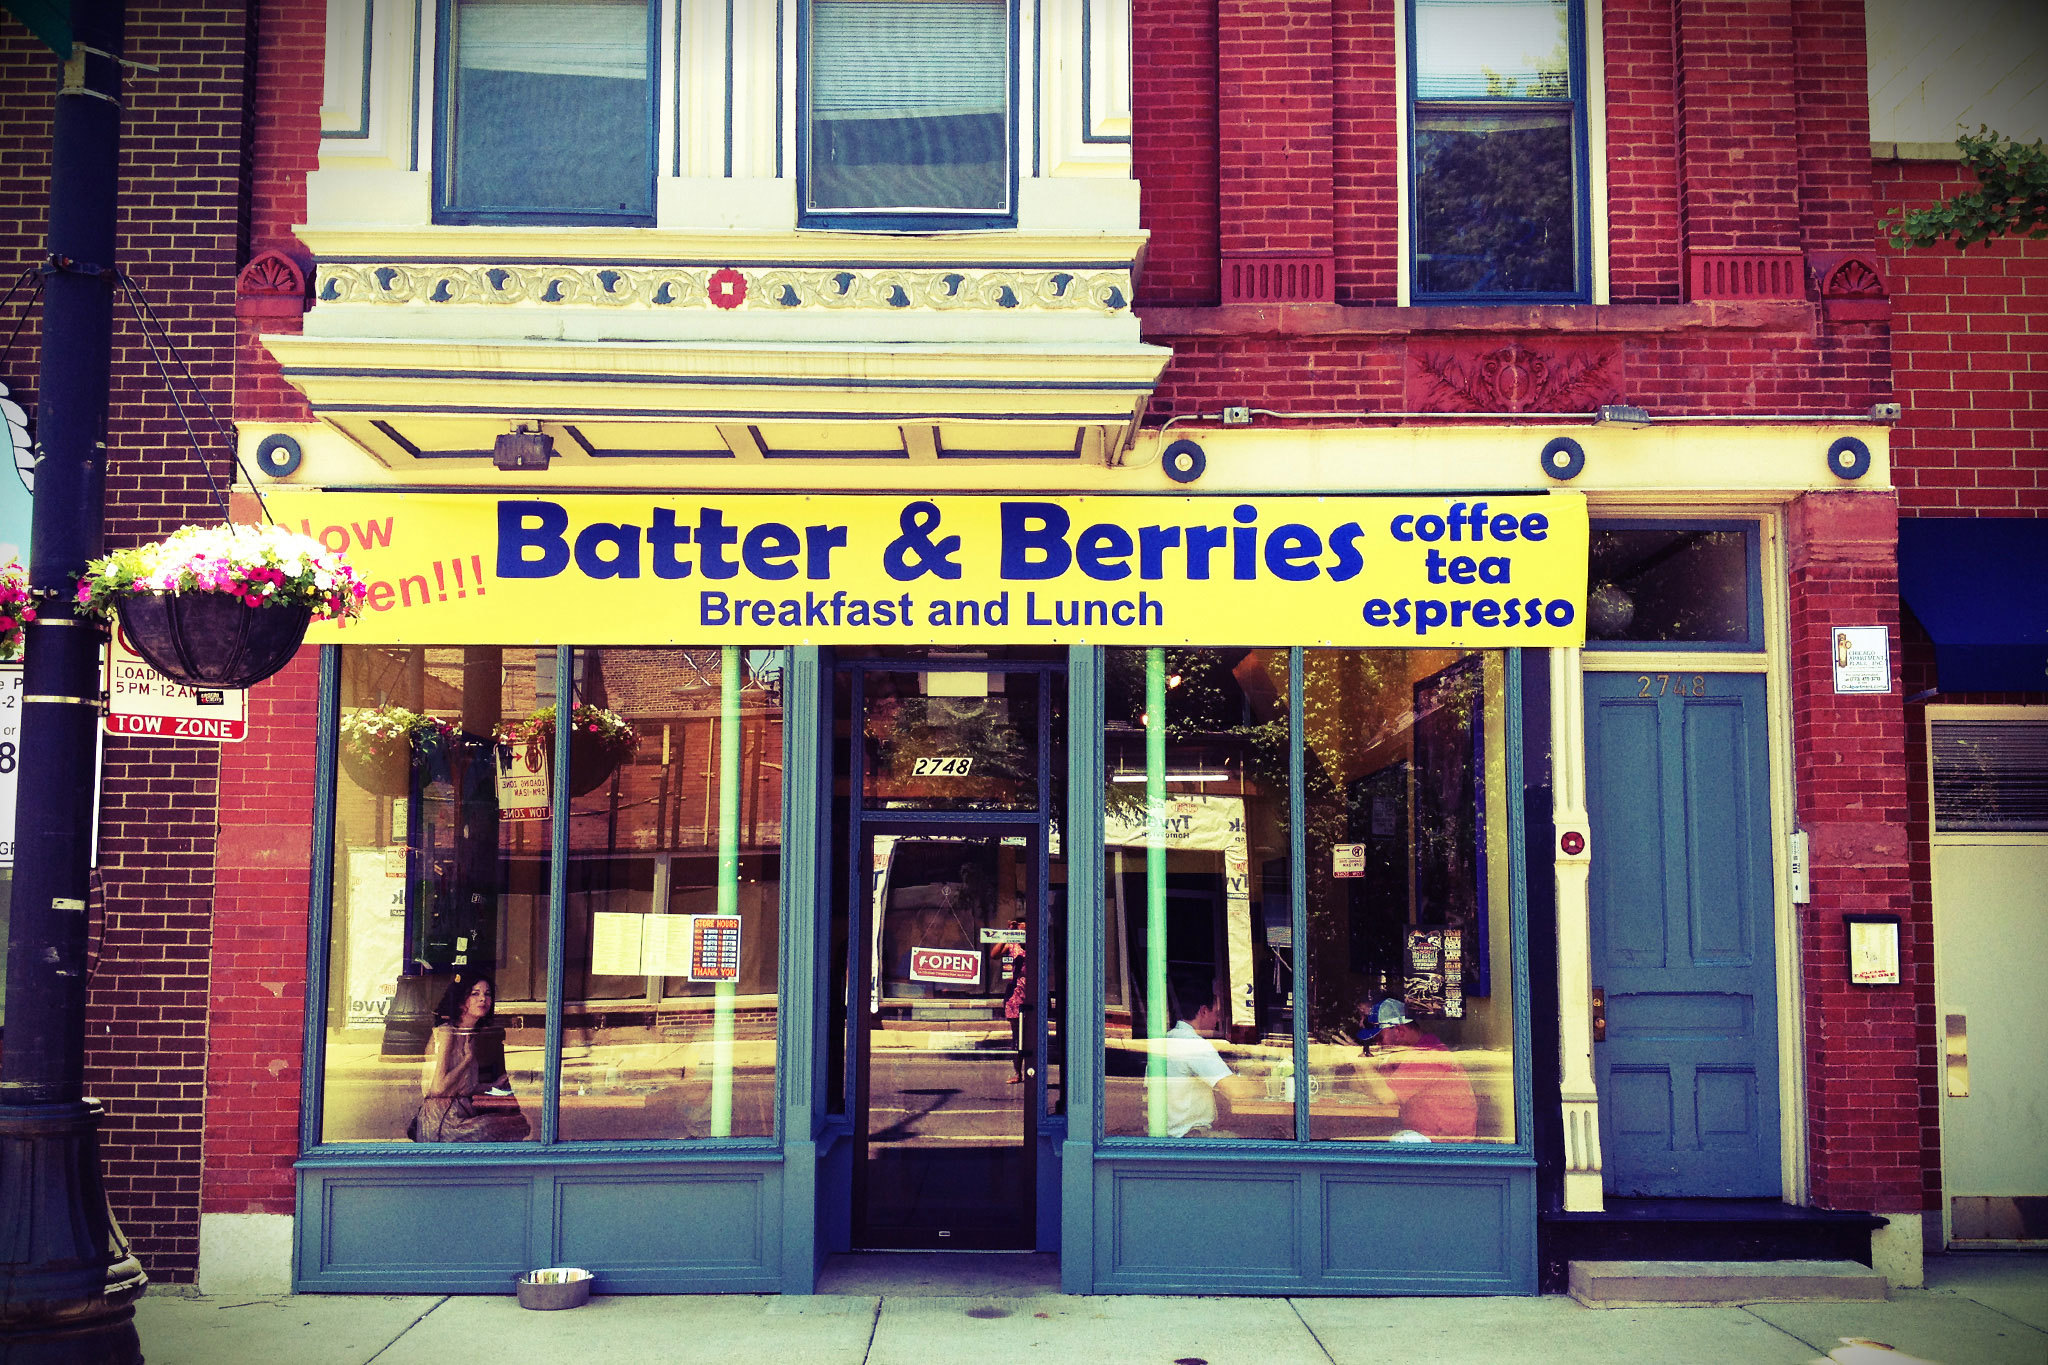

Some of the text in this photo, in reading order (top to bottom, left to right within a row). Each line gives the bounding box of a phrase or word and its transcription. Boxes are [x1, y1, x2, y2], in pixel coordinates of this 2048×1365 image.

[1390, 502, 1549, 542] coffee
[496, 500, 1365, 582] Batter & Berries
[1425, 548, 1511, 585] tea
[700, 590, 1164, 627] Breakfast and Lunch
[1363, 597, 1575, 636] espresso
[1637, 674, 1705, 697] 2748
[115, 715, 233, 738] TOW ZONE
[915, 759, 970, 775] 2748
[694, 919, 738, 928] STORE HOURS
[693, 967, 736, 977] THANK YOU
[928, 955, 974, 971] OPEN
